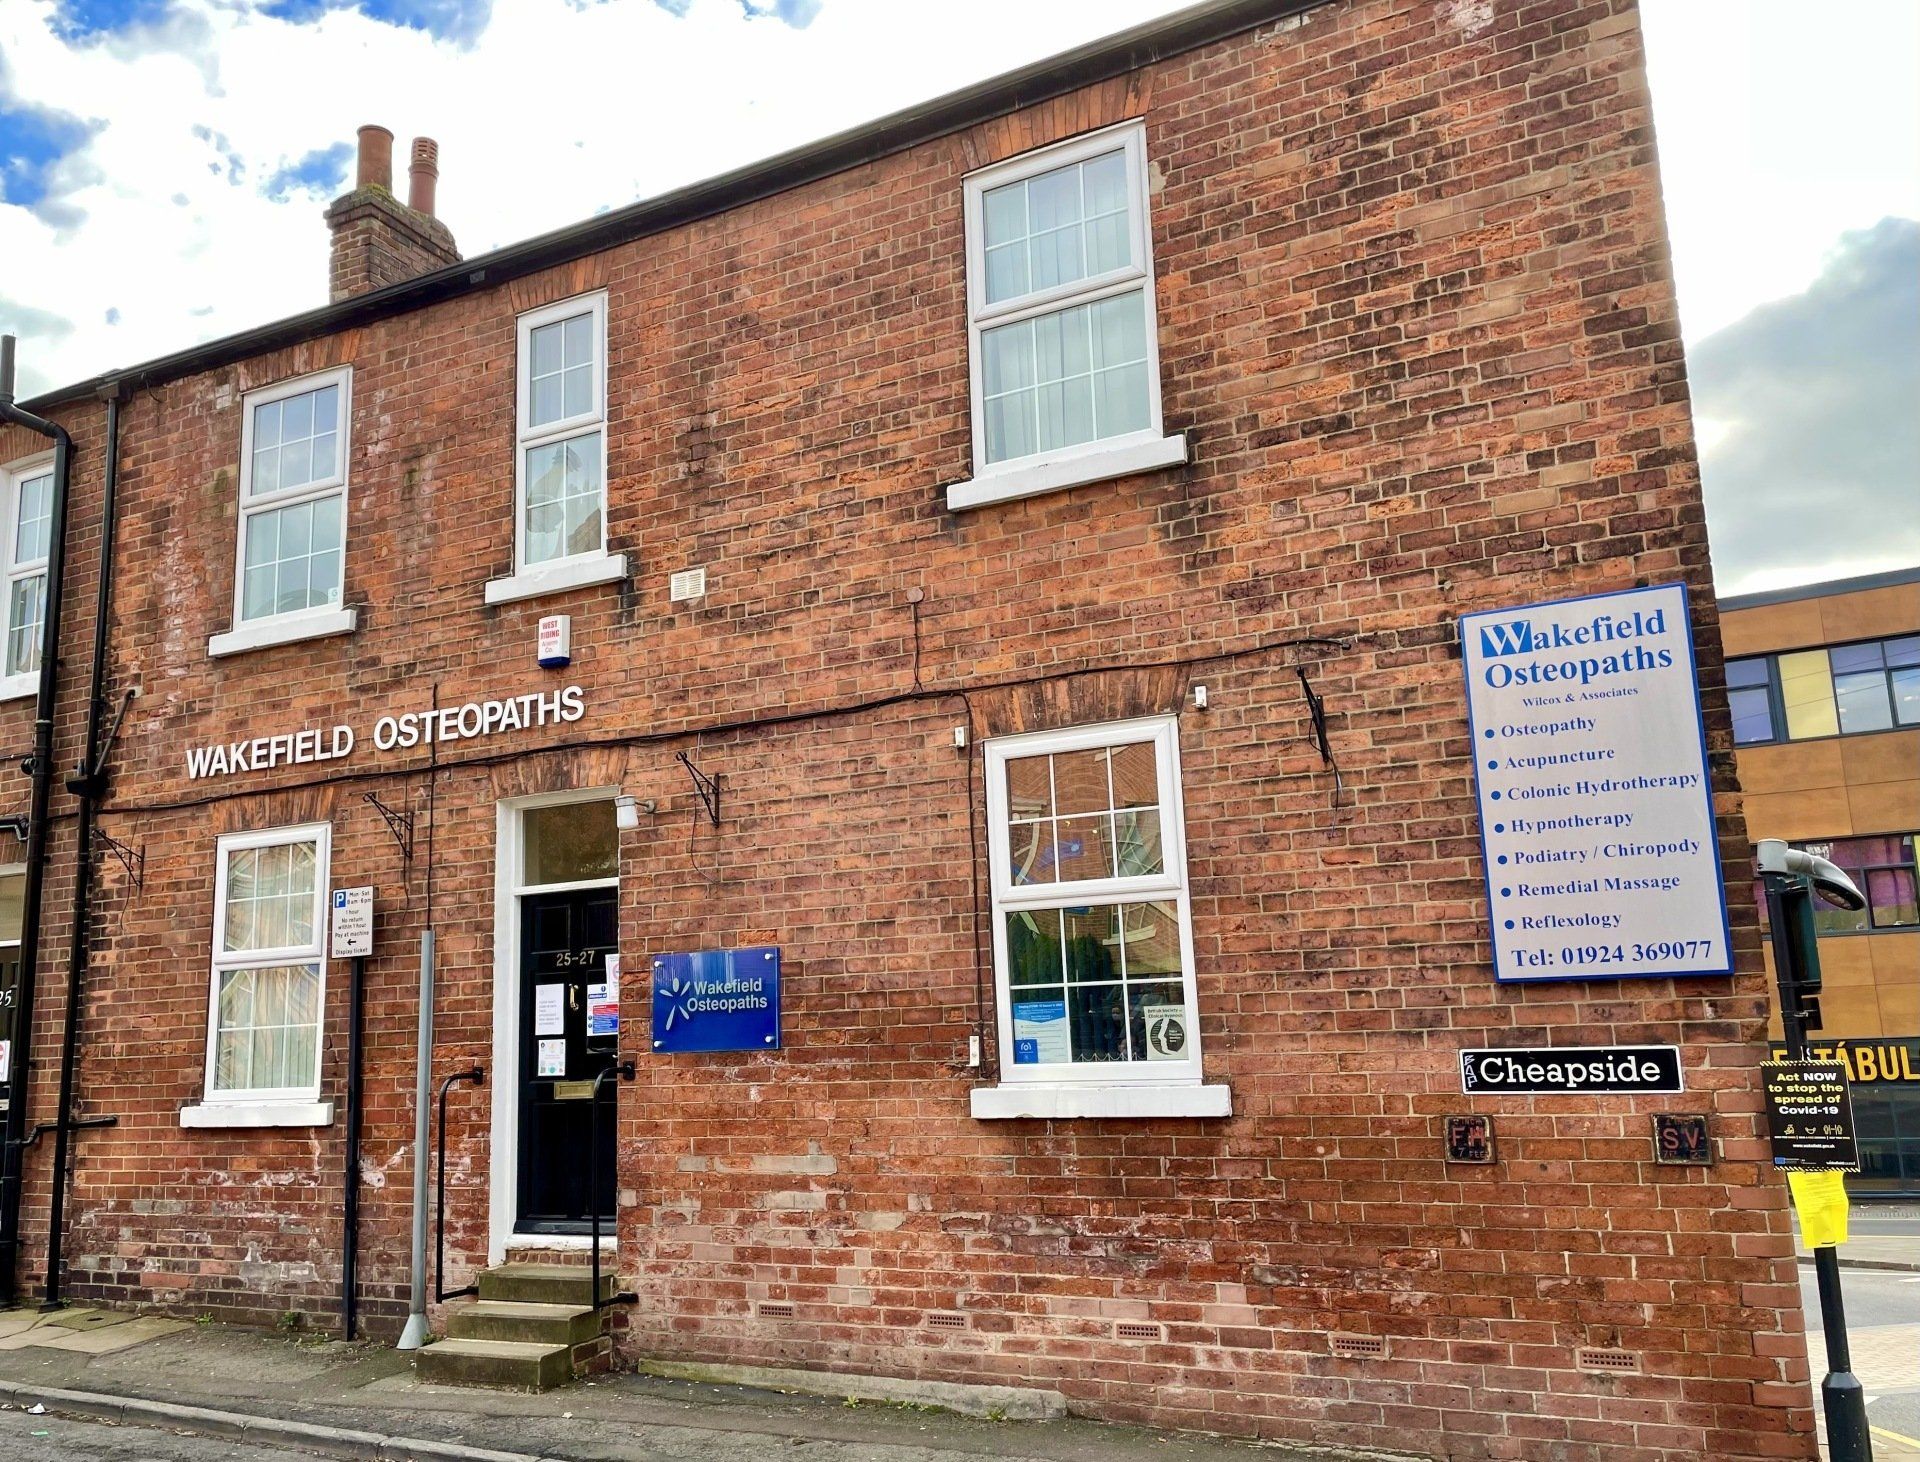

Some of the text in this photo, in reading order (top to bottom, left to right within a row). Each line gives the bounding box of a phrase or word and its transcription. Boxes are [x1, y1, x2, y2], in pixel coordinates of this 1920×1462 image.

[542, 620, 558, 630] WEST
[1481, 609, 1666, 657] Wakefield
[1485, 646, 1673, 688] Osteopaths
[1522, 686, 1639, 708] Wilcox & Associates
[186, 685, 585, 779] WAKEFIELD OSTEOPATHS
[1501, 717, 1597, 738] Osteopathy
[1504, 748, 1616, 770] Acupuncture
[1507, 773, 1700, 801] Colonic Hydrotherapy
[1511, 812, 1634, 835] Hypnotherapy
[1514, 848, 1588, 865] Podiatry
[1603, 839, 1700, 858] Chiropody
[1518, 876, 1681, 897] Remedial Massage
[336, 893, 344, 907] P
[1521, 912, 1622, 930] Reflexology
[556, 950, 595, 967] 25-27
[1511, 940, 1712, 967] Tel: 01924 369077
[693, 977, 762, 995] Wakefield
[687, 994, 768, 1013] Osteopaths
[1480, 1055, 1661, 1088] Cheapside
[1773, 1041, 1920, 1081] TÁBUL
[1776, 1072, 1837, 1082] Act NOW
[1768, 1083, 1844, 1094] to stop the
[1774, 1094, 1841, 1105] spread of
[1779, 1106, 1839, 1115] Covid-19
